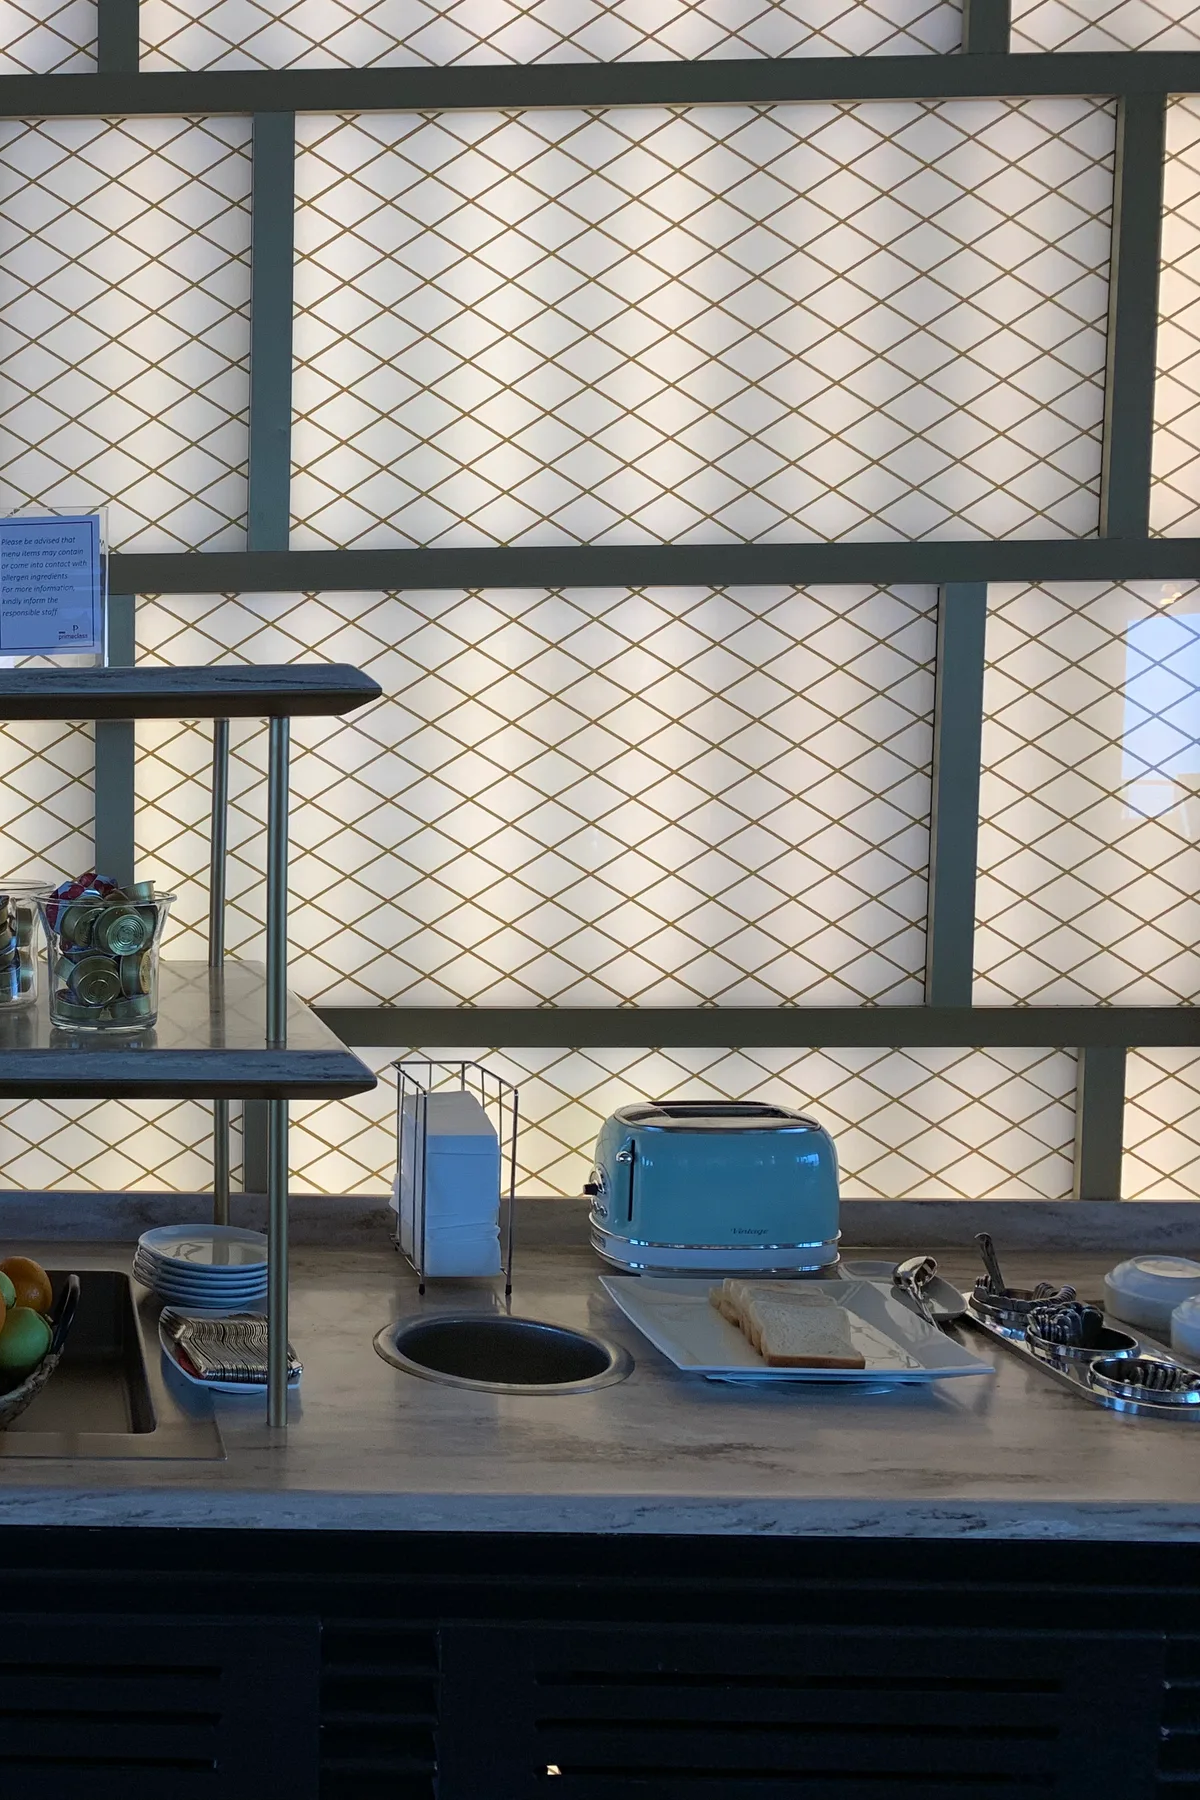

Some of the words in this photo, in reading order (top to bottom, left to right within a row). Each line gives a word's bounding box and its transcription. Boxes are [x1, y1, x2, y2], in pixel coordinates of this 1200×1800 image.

[24, 537, 32, 545] be
[61, 536, 76, 544] that
[1, 574, 29, 582] allergen
[33, 584, 75, 593] information,
[23, 597, 46, 605] inform
[47, 596, 58, 604] the
[2, 609, 40, 617] responsible
[730, 1227, 768, 1236] Vintage
